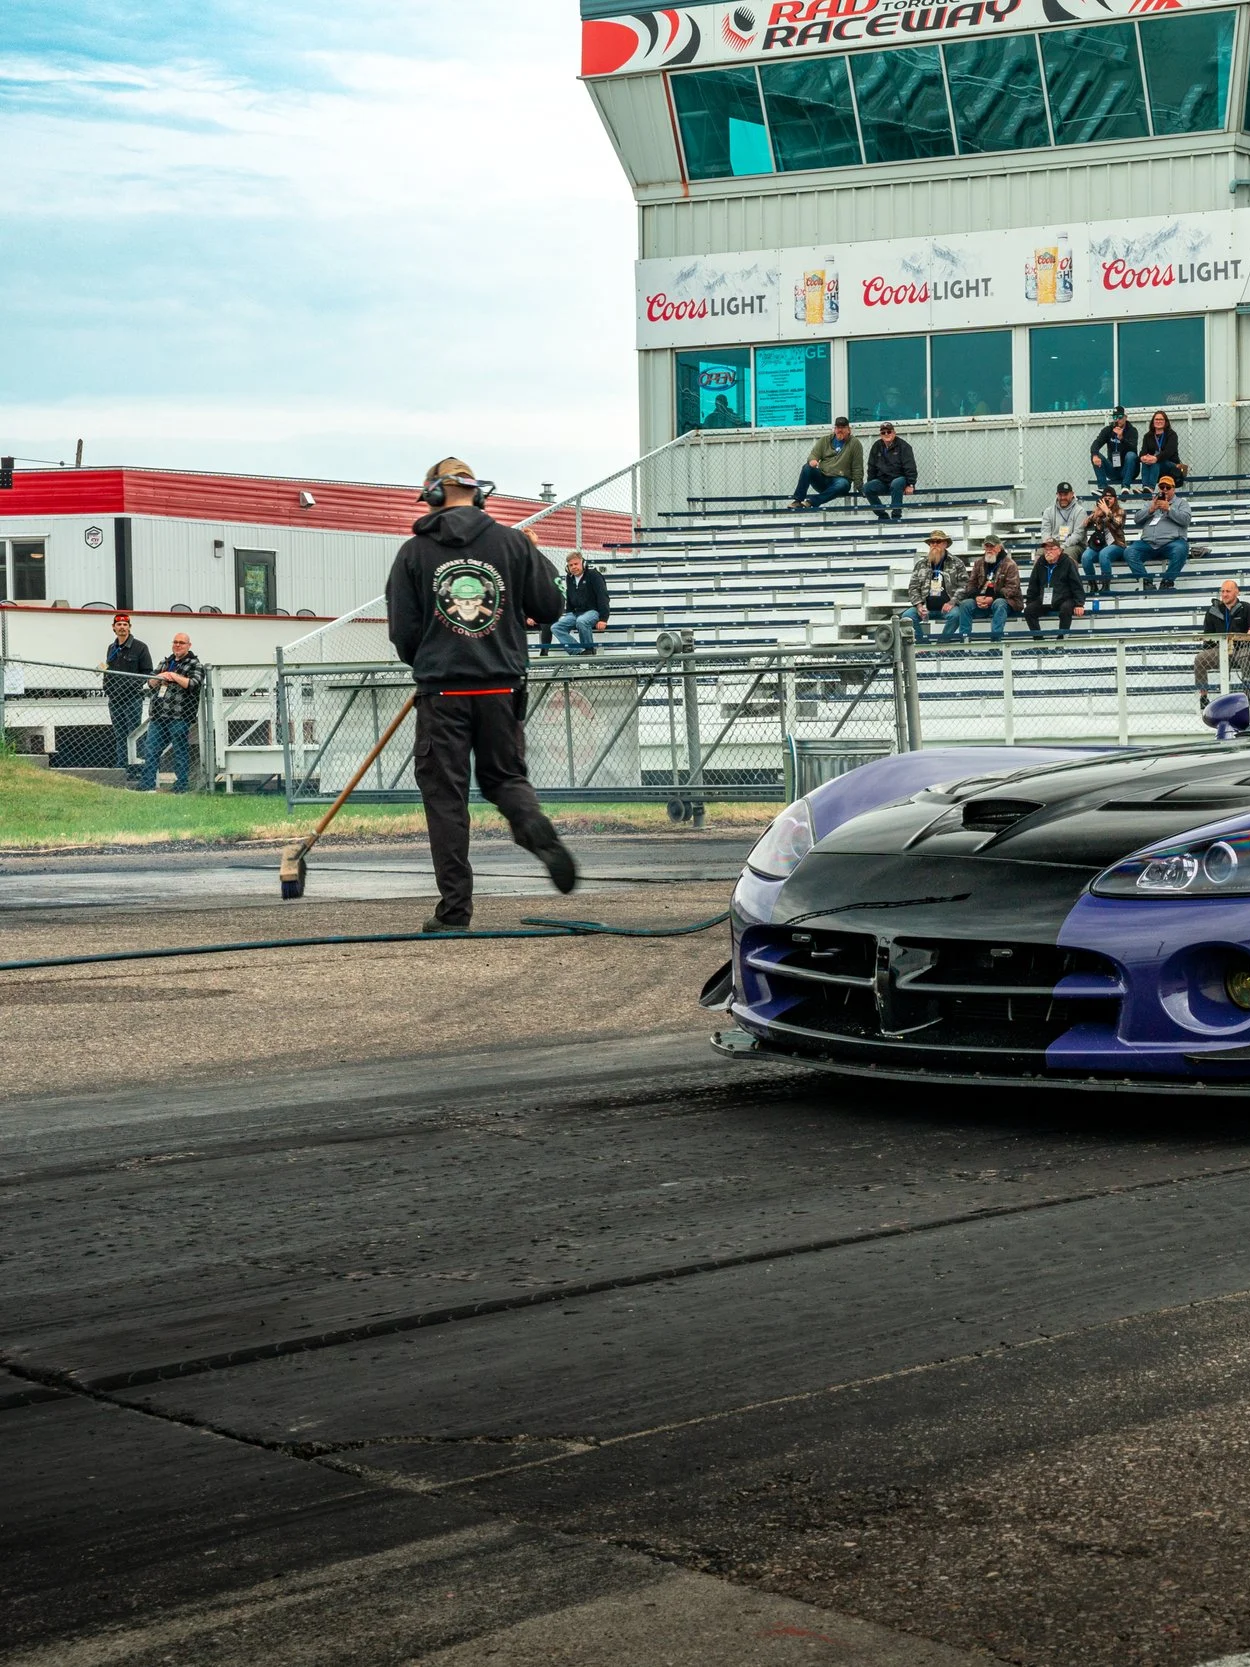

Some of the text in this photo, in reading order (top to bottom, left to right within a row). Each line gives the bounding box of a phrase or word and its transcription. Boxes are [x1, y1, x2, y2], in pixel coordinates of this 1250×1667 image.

[762, 0, 1022, 50] RACEWAY
[768, 0, 960, 25] RAD TORQU
[1101, 258, 1242, 291] Coors LIGHT
[862, 276, 992, 307] Coors LIGHT
[646, 292, 767, 322] Coors LIGHT
[698, 371, 735, 386] OPEN
[483, 562, 507, 592] SOLUTION
